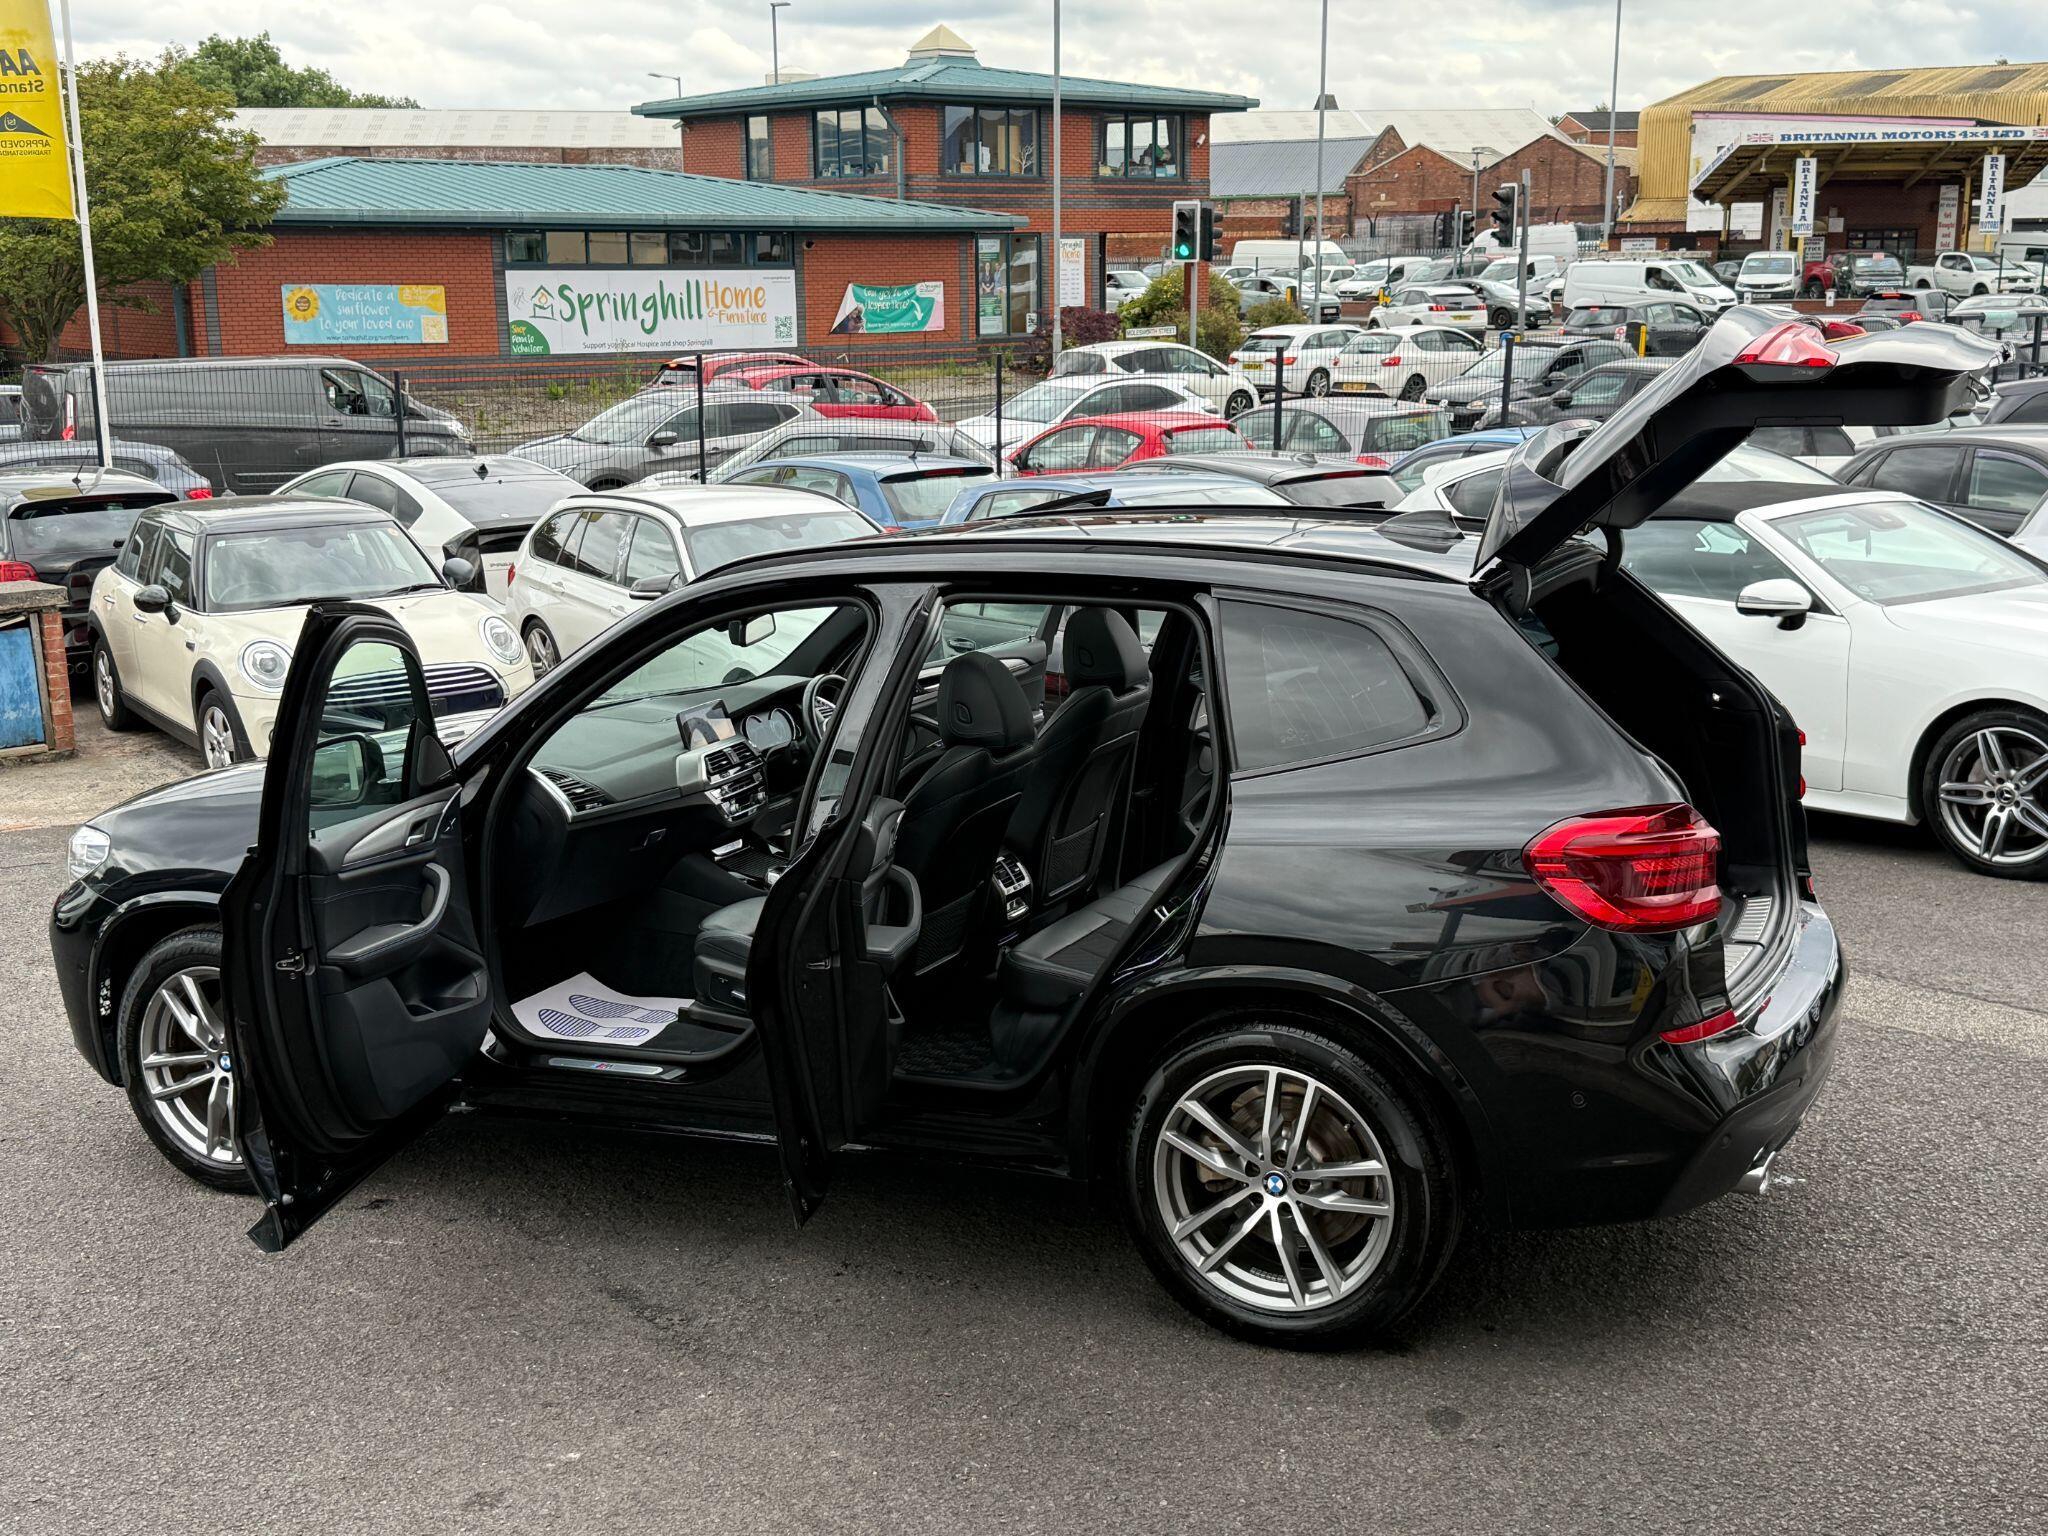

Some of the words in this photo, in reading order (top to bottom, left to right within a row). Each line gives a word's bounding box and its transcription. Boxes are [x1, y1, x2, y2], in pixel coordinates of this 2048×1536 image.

[1780, 132, 1877, 141] BRITANNIA
[1882, 130, 1956, 139] MOTORS
[1959, 130, 1989, 139] 4x4
[1993, 129, 2026, 138] LTD
[1799, 160, 1811, 222] BRITANNIA
[1985, 156, 1999, 219] BRITANNIA
[335, 288, 382, 302] Dedicate
[386, 290, 394, 301] a
[704, 280, 766, 309] Home
[336, 302, 390, 316] sunflower
[718, 306, 768, 324] Furniture
[319, 317, 331, 330] to
[335, 319, 359, 333] your
[362, 316, 393, 330] loved
[396, 319, 414, 329] one
[512, 344, 544, 354] Volunteer
[582, 341, 606, 350] Support
[637, 340, 660, 349] Hospice
[660, 339, 671, 347] and
[672, 339, 687, 348] shop
[687, 338, 713, 347] Springhill
